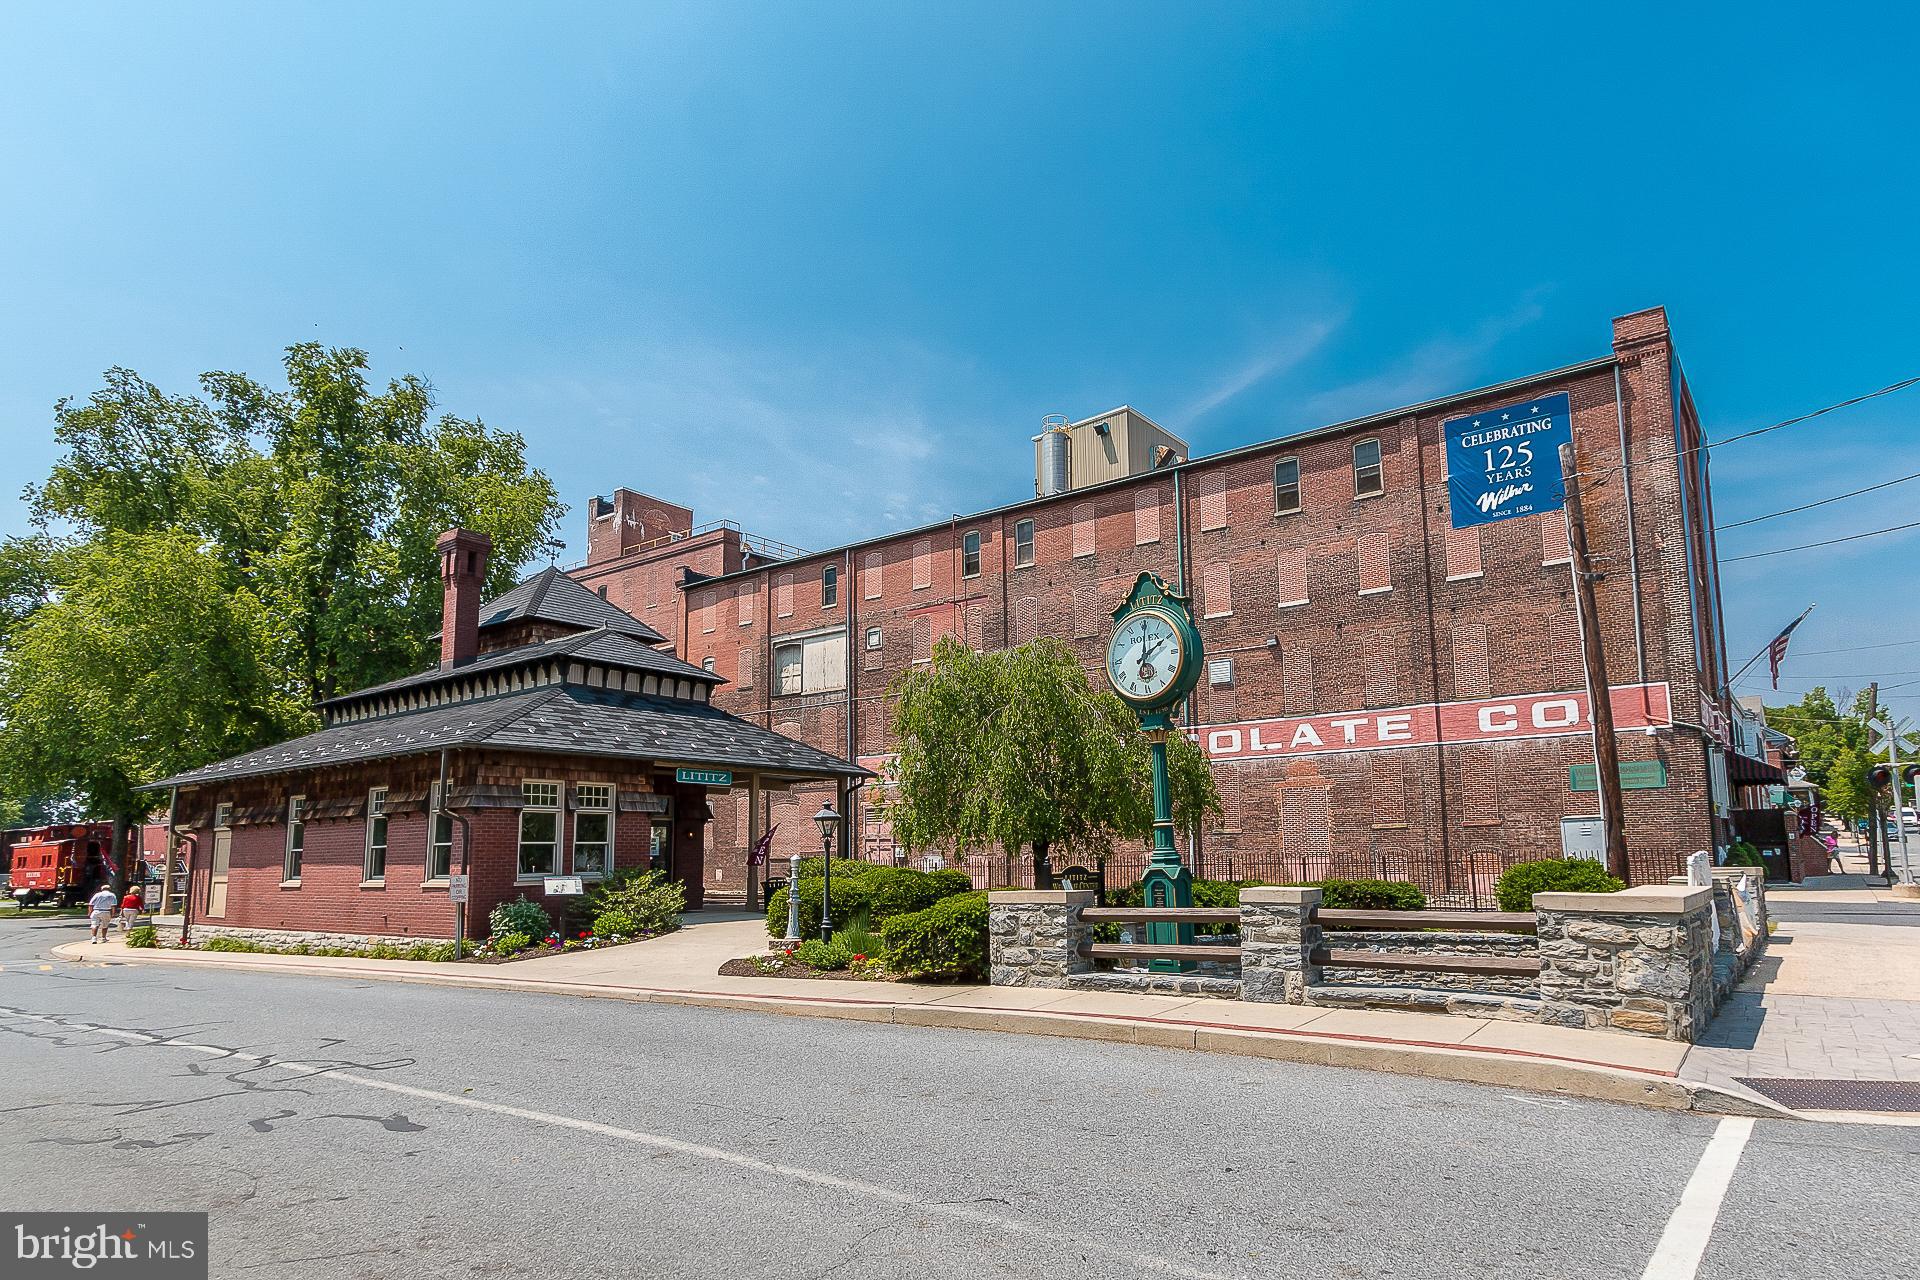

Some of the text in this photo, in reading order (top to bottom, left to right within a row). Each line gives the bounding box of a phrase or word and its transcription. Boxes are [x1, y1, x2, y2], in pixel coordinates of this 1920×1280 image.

[1461, 417, 1552, 448] CELEBRATING
[1483, 440, 1533, 473] 125
[1486, 466, 1532, 484] YEARS
[1476, 482, 1533, 513] Wilbur
[1492, 504, 1533, 518] SINCE 1884
[1130, 595, 1163, 610] LITITZ
[1130, 633, 1160, 645] ROEX
[1188, 714, 1413, 755] OLATE
[682, 771, 727, 782] LITITZ
